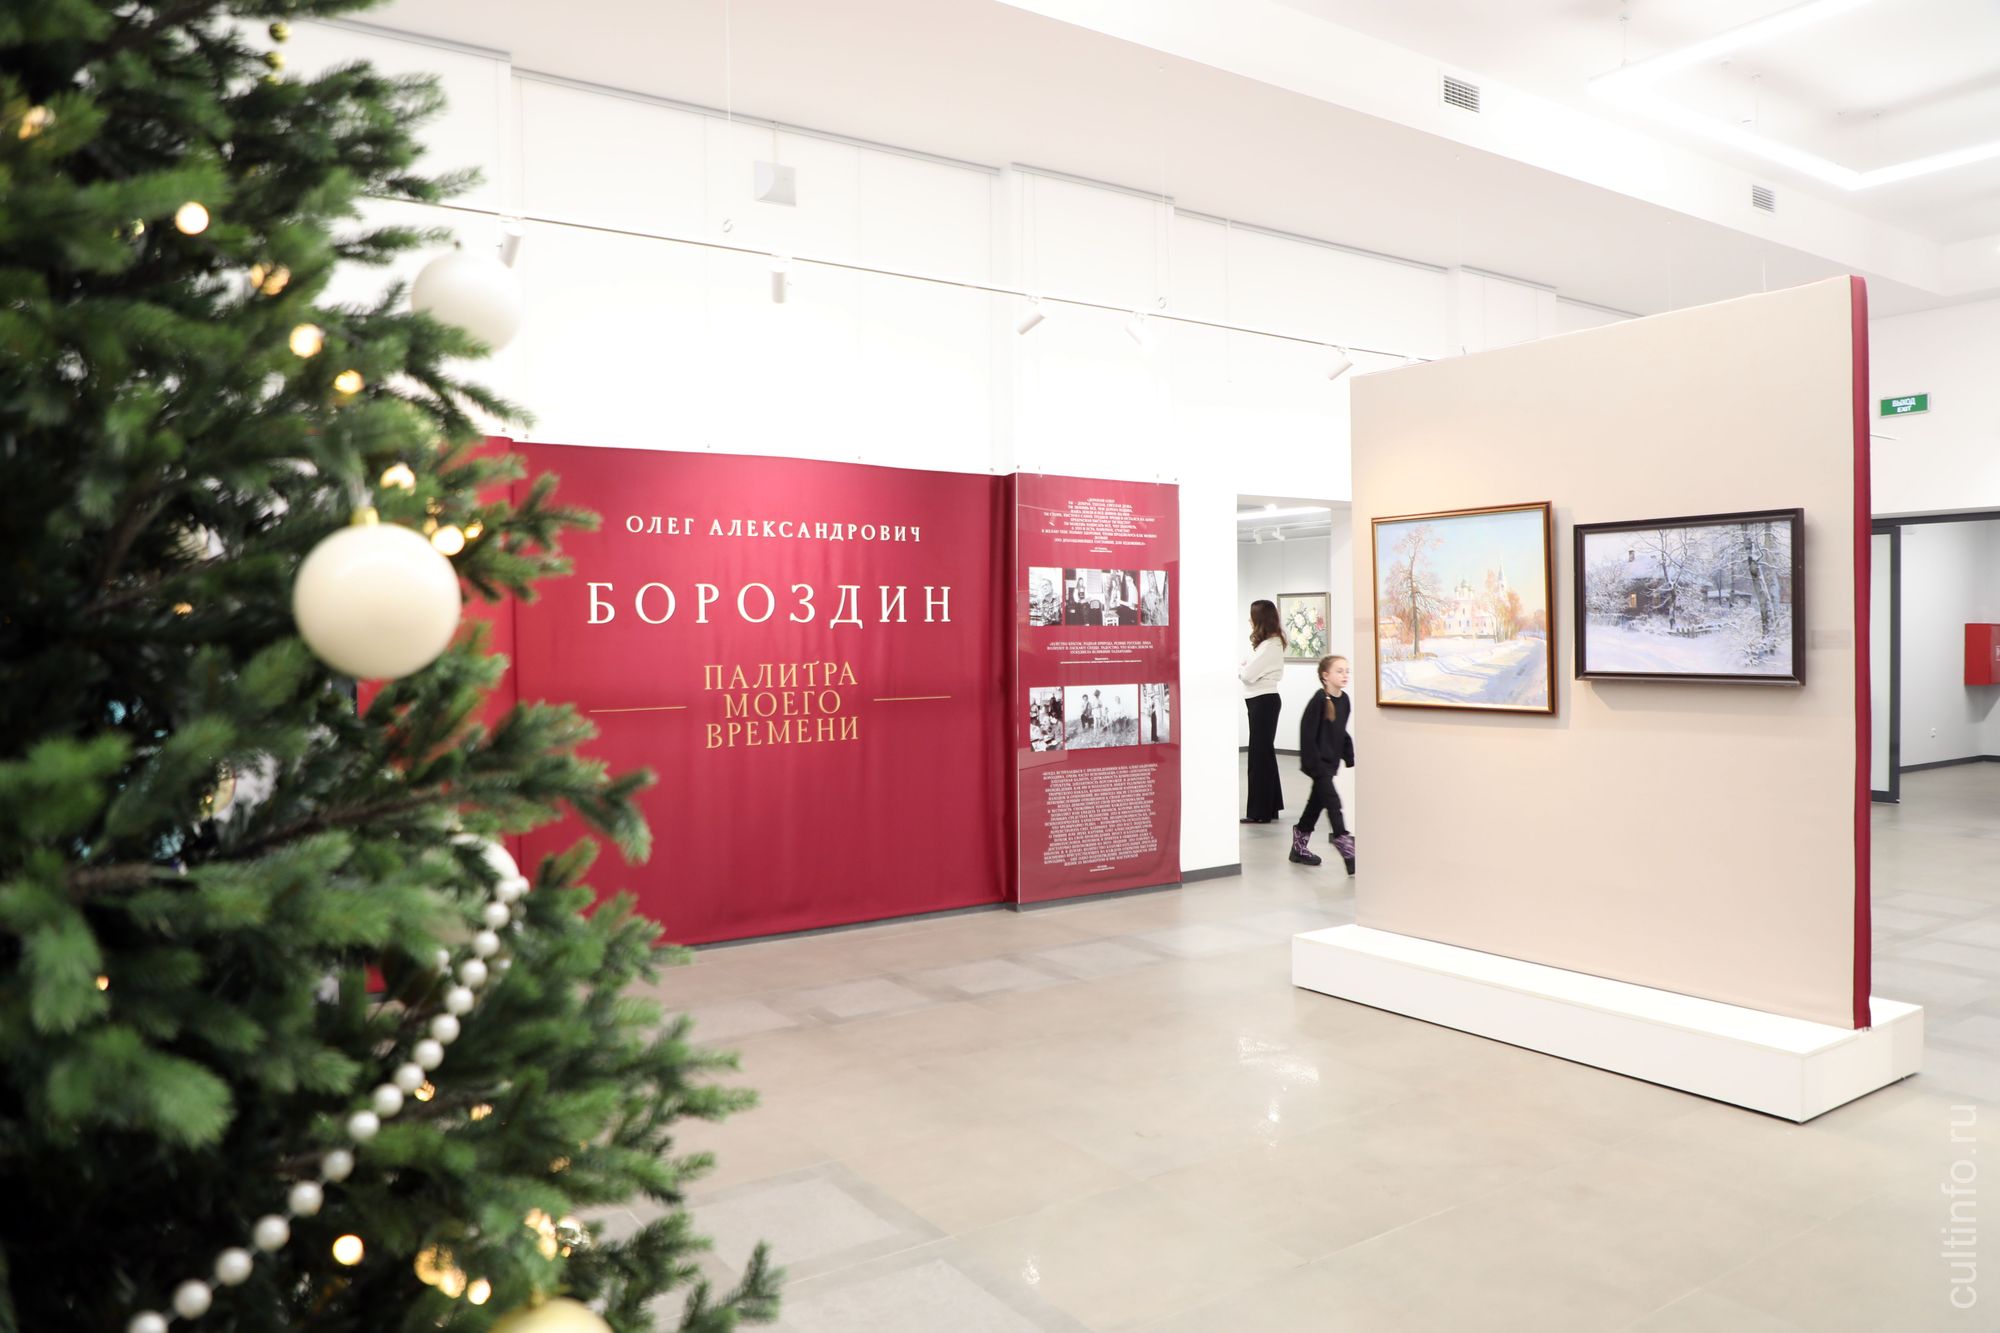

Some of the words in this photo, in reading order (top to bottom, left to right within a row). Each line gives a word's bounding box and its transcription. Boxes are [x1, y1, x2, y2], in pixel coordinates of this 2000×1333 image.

[1892, 398, 1916, 407] ВЫХОД
[625, 515, 695, 536] ОЛЕГ
[709, 518, 922, 543] АЛЕКСАНДРОВИЧ
[586, 581, 952, 630] БОРОЗДИН
[703, 660, 858, 691] ПАЛИТРА
[724, 689, 842, 719] МОЕГО
[705, 716, 860, 749] ВРЕМЕНИ
